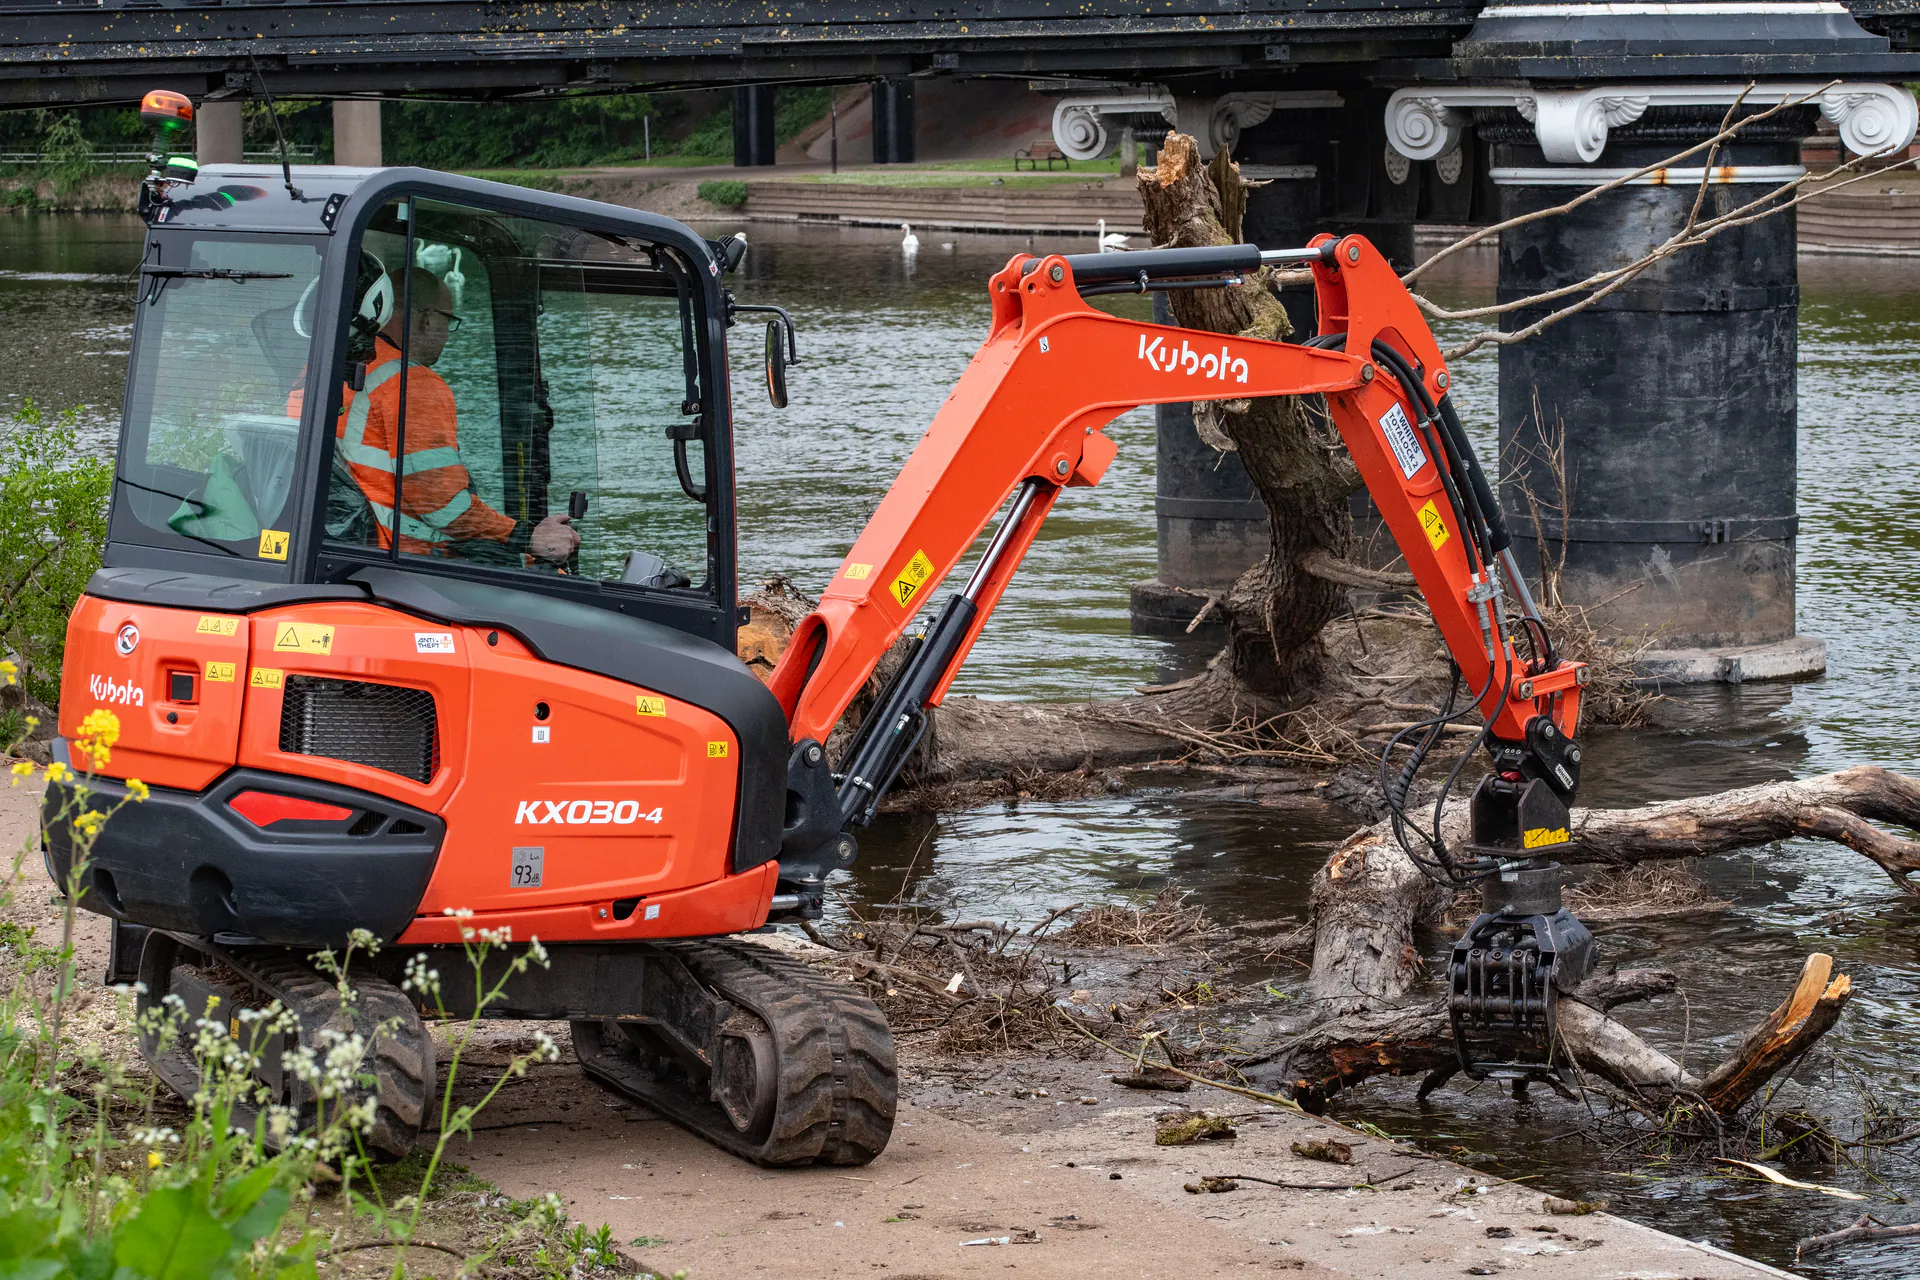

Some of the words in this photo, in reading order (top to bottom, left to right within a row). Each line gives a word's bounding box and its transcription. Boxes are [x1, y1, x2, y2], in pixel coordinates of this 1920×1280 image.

[1138, 334, 1248, 384] Kubota
[1389, 412, 1415, 462] TOTALOCK
[1399, 416, 1420, 454] WHITES
[90, 674, 144, 706] Kubota
[514, 800, 662, 824] KX030-4
